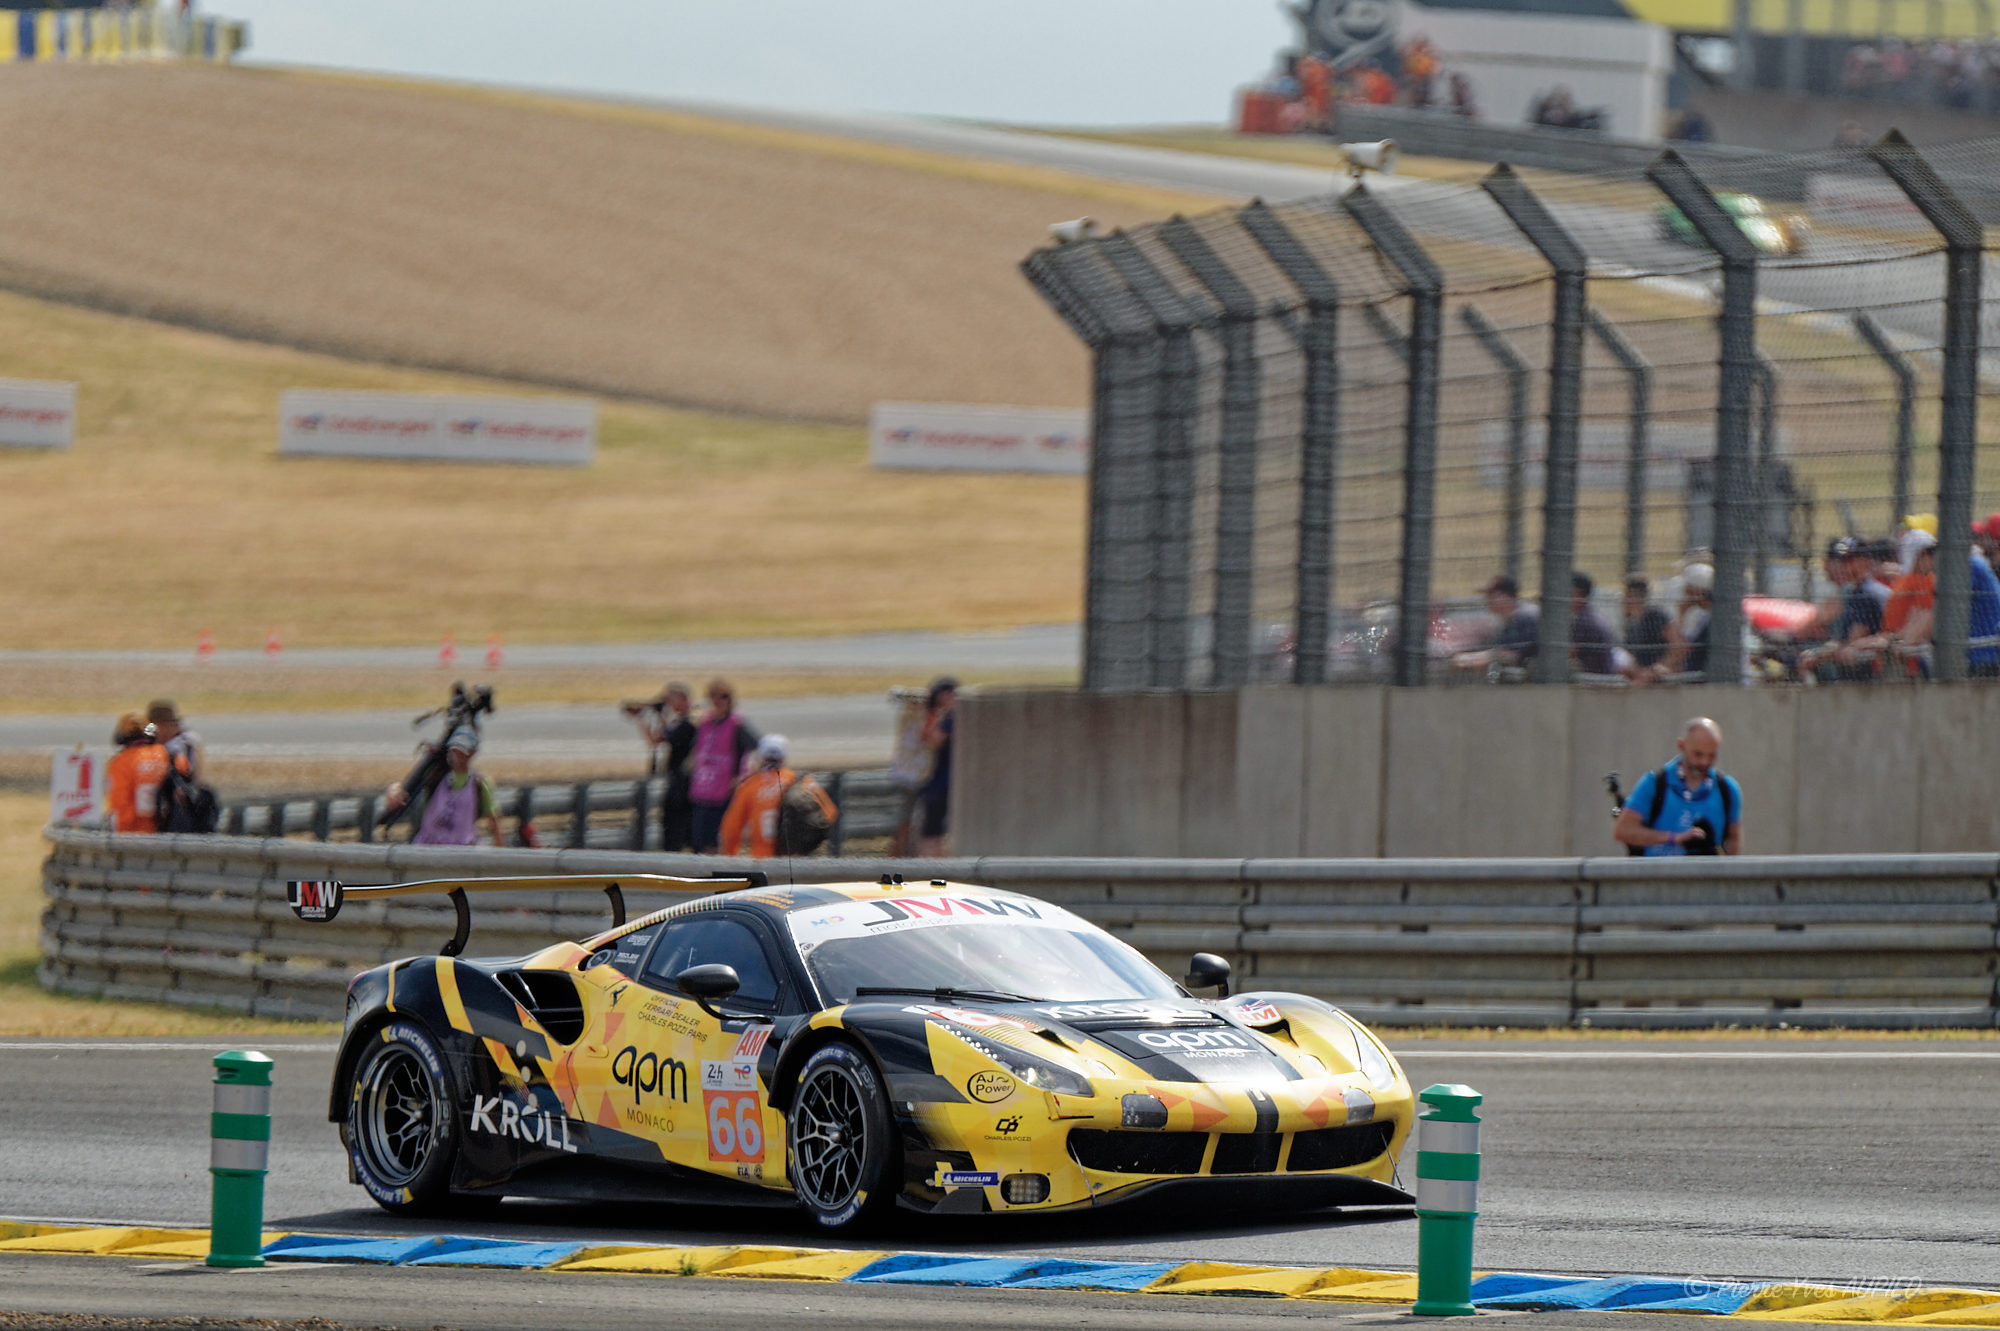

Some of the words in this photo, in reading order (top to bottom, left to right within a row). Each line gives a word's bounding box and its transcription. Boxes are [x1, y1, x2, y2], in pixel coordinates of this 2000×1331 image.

[290, 881, 337, 908] JMW
[863, 898, 1042, 926] JMW
[643, 1002, 674, 1018] FERRARI
[672, 1012, 701, 1026] DEALER
[650, 994, 681, 1010] OFFICIAL
[638, 1011, 668, 1028] CHARLES
[667, 1021, 688, 1035] POZZI
[687, 1029, 708, 1042] PARIS
[397, 1026, 440, 1073] MICHELIN
[736, 1030, 769, 1056] AM
[1138, 1031, 1249, 1052] apm
[1183, 1051, 1245, 1059] MONACO
[612, 1045, 688, 1106] apm
[976, 1074, 994, 1084] AJ
[976, 1084, 1011, 1096] Power
[627, 1107, 674, 1133] MONACO
[709, 1096, 762, 1157] 66
